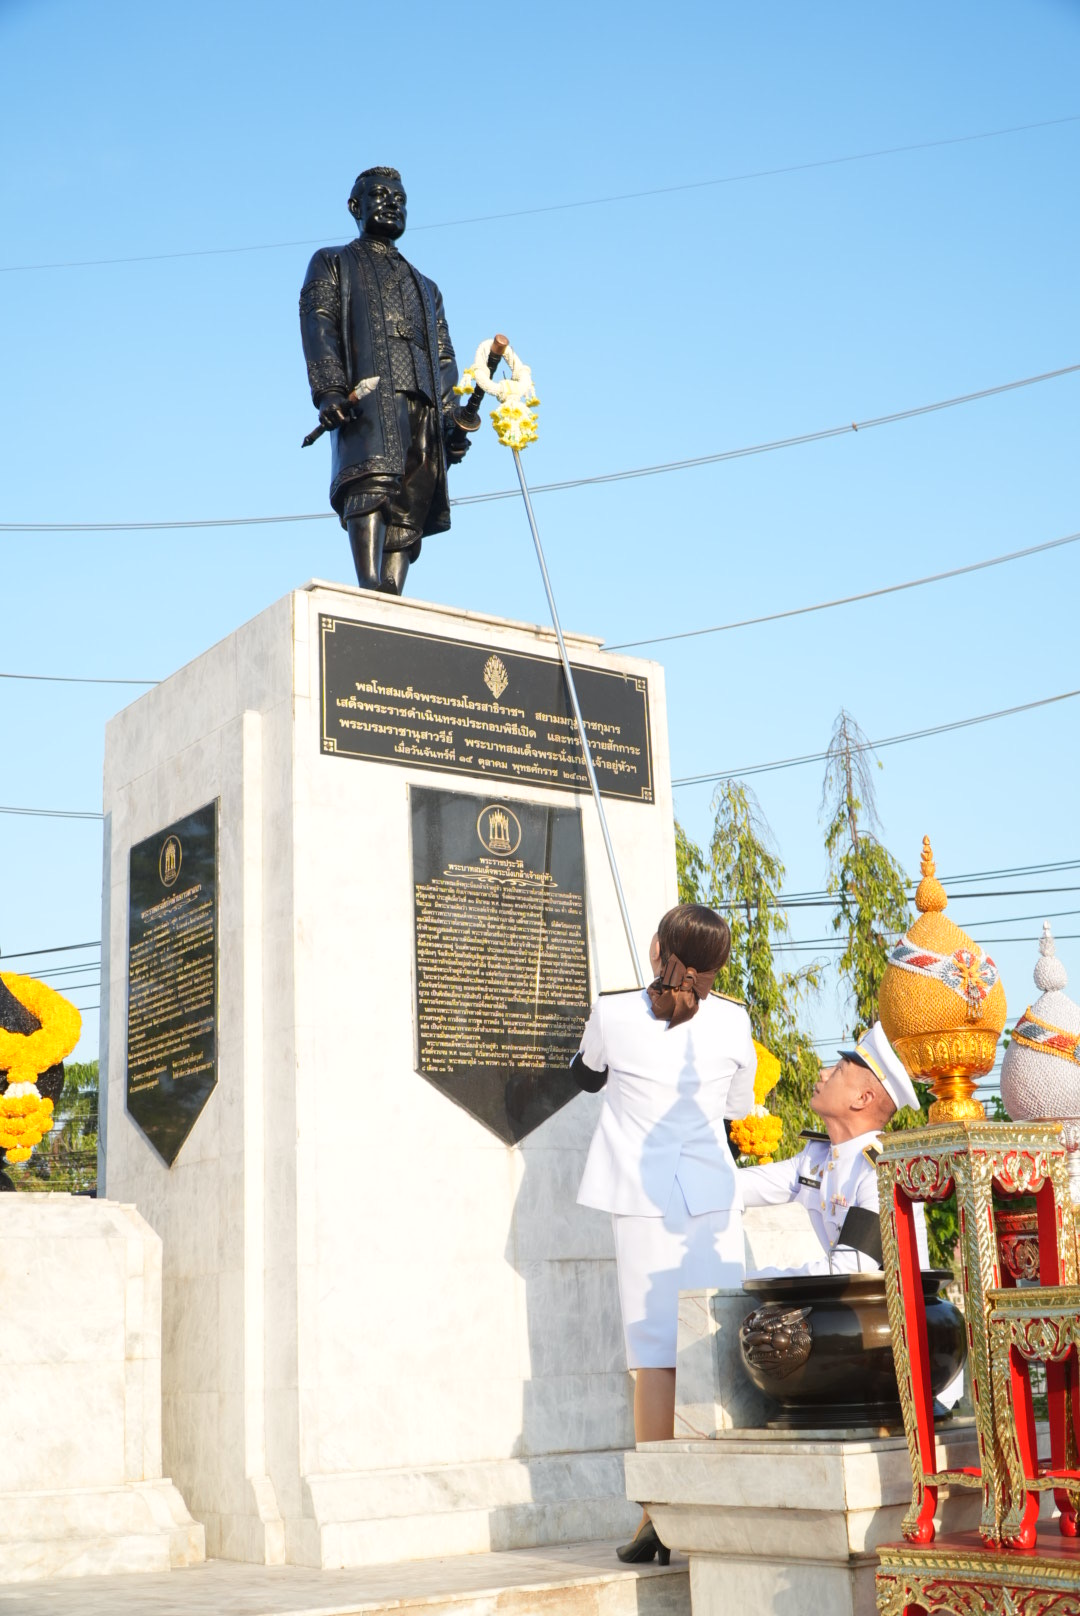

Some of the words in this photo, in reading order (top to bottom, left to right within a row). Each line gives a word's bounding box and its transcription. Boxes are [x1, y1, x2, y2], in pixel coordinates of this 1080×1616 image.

[336, 696, 537, 738] เสด็จพระราชดำเนินทรงประกอบพิธีเปิด
[355, 680, 525, 718] พลโทสมเด็จพระบรมโอรสาธิราชฯ
[339, 718, 453, 743] พระบรมราชานุสาวรีย์
[464, 738, 637, 774] พระบาทสมเด็จพระนั่งเกล้เจ้าอยู่หัวฯ
[394, 740, 456, 761] เมื่อวันจันทร์ที่
[478, 758, 508, 769] ตุลาคม
[512, 762, 558, 777] พุทธศักราช
